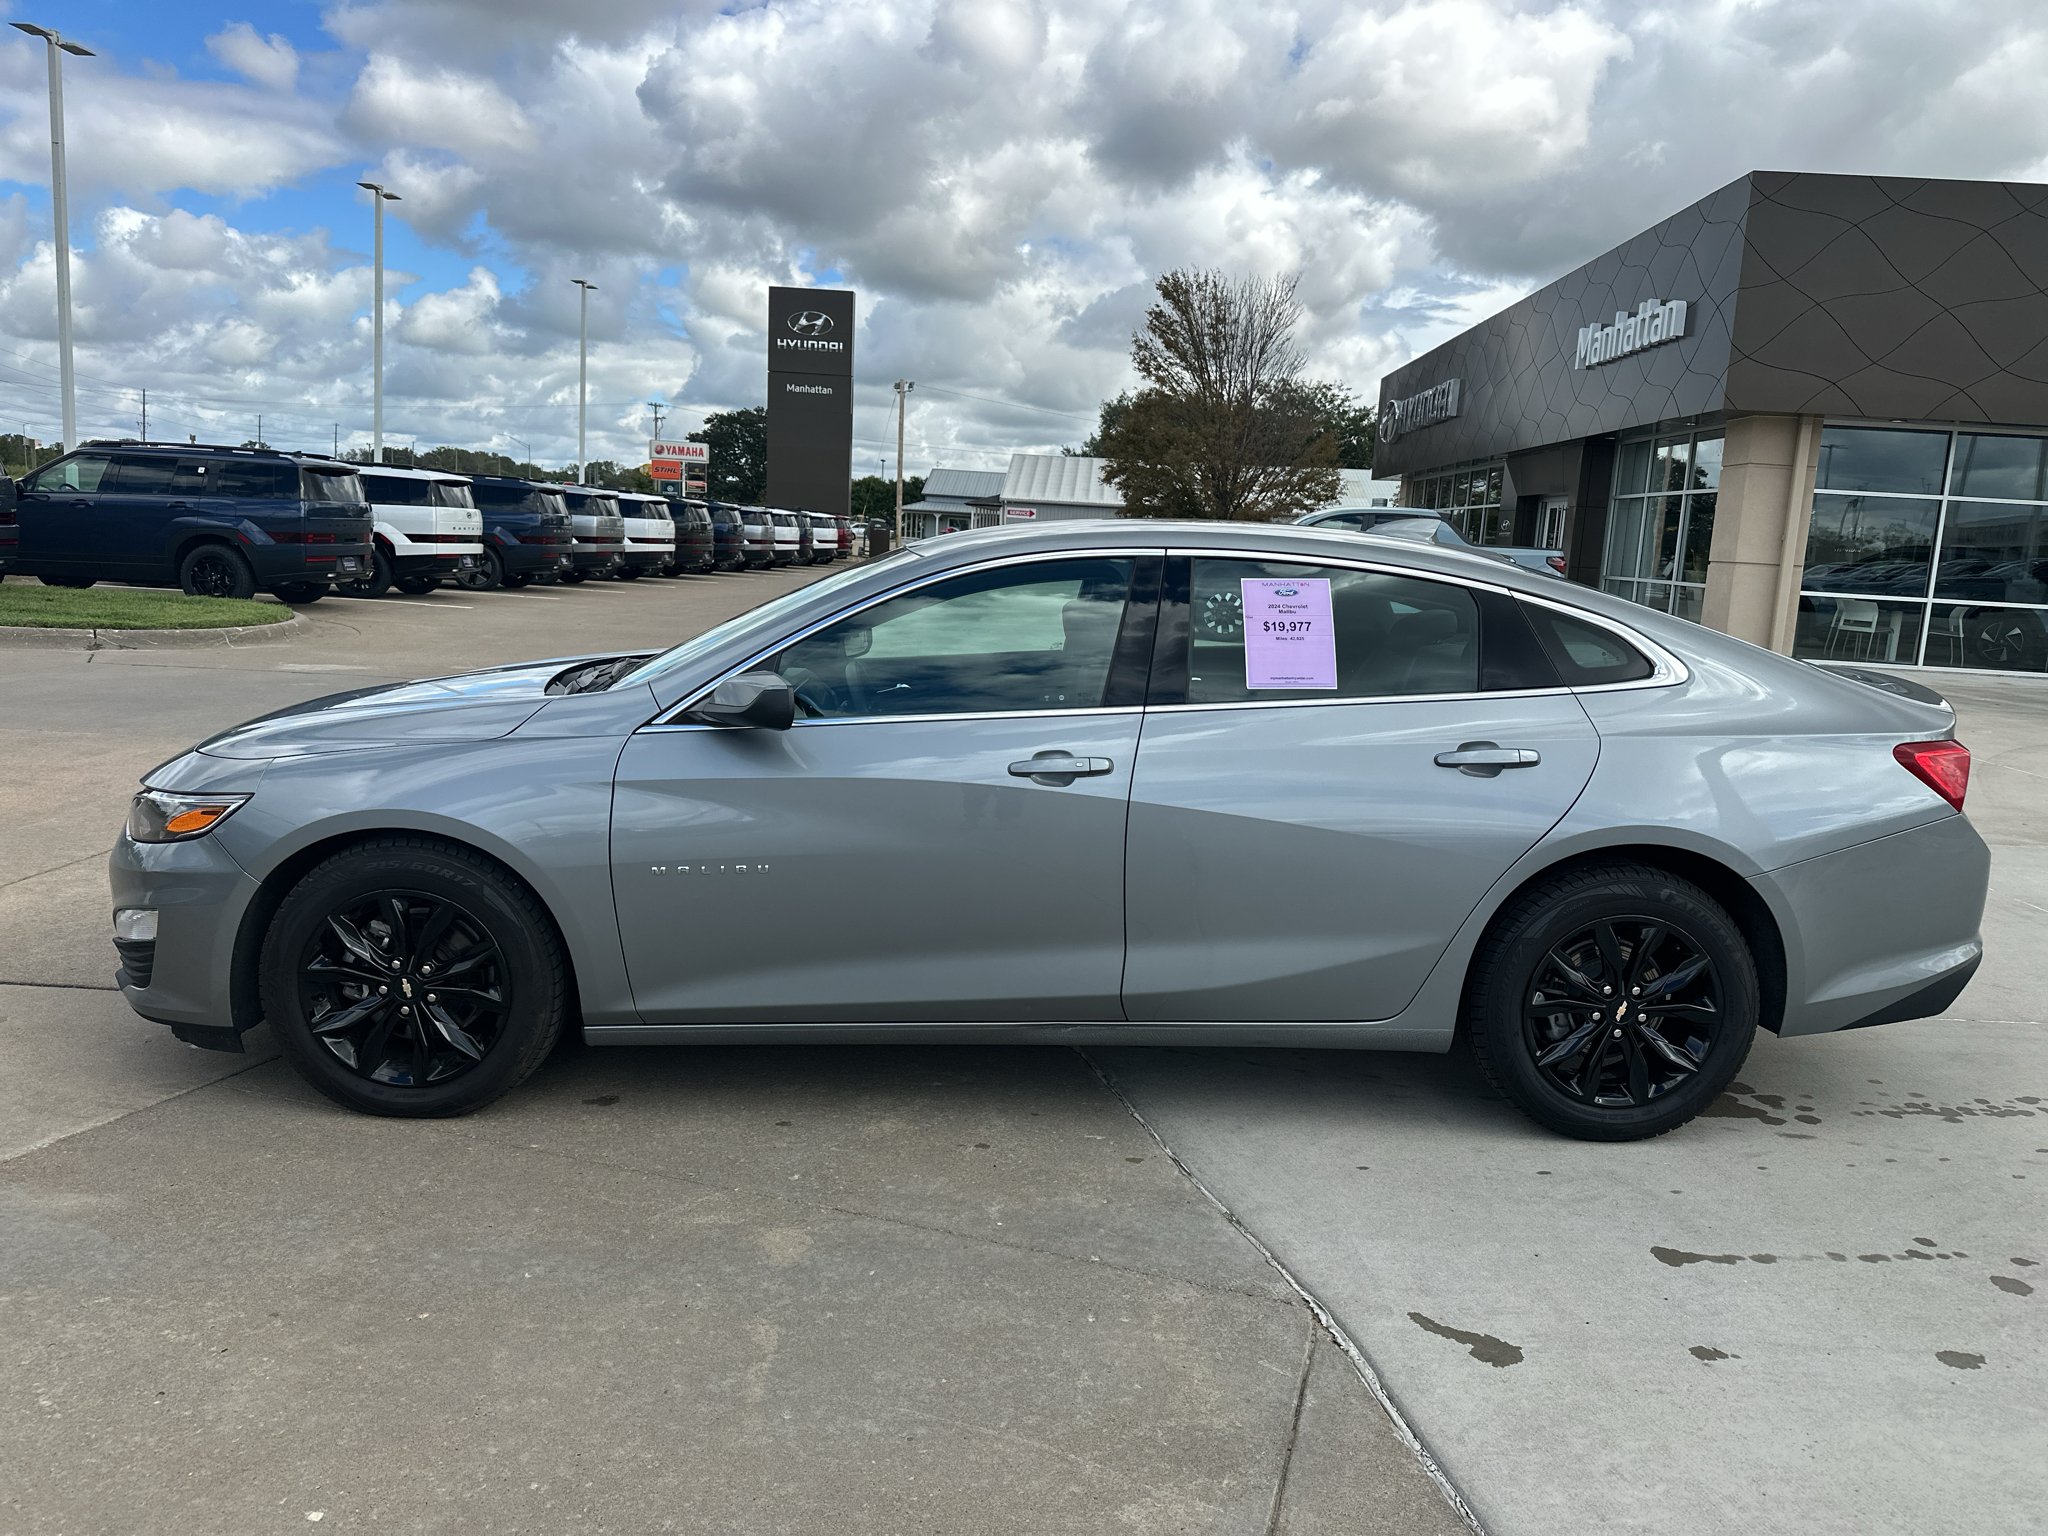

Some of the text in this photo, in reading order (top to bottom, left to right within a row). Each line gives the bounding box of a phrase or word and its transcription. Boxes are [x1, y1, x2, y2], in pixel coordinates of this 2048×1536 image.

[1575, 298, 1687, 370] Manhattan
[777, 338, 844, 352] HYUNDAI
[786, 383, 833, 395] Manhattan
[666, 445, 705, 457] YAMAHA
[654, 466, 678, 474] STIHL
[1263, 620, 1312, 633] $19,977
[651, 864, 769, 876] MALIBU
